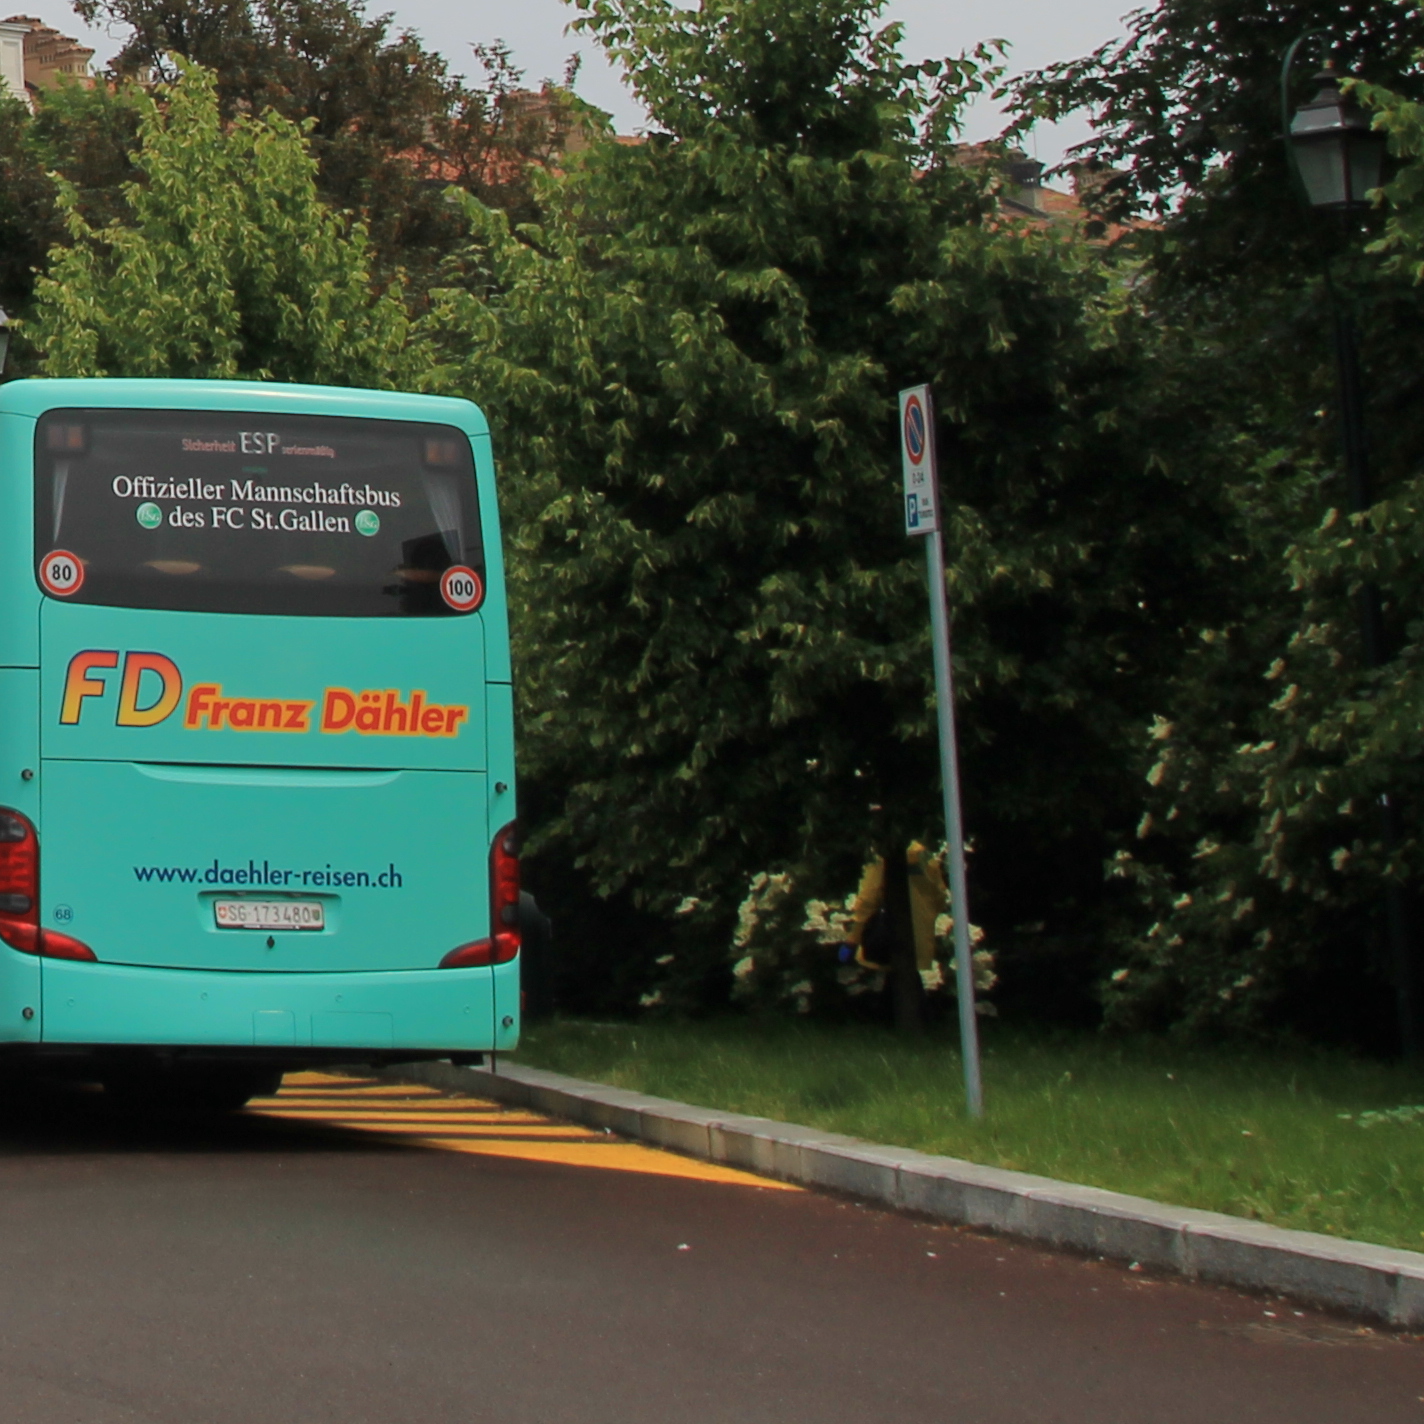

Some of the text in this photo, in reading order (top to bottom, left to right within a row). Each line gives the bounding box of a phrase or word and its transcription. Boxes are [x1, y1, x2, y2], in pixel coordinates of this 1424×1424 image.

[239, 432, 280, 454] ESP
[112, 475, 401, 507] Offizieller Mannschaftsbus
[168, 506, 205, 528] des
[211, 507, 244, 529] FC
[251, 508, 350, 533] St.Gallen
[52, 564, 72, 581] 80
[449, 579, 473, 596] 100
[58, 649, 183, 727] FD
[183, 683, 469, 738] Franz Dähler
[133, 859, 403, 888] www.daehler-reisen.ch
[55, 909, 71, 920] 68
